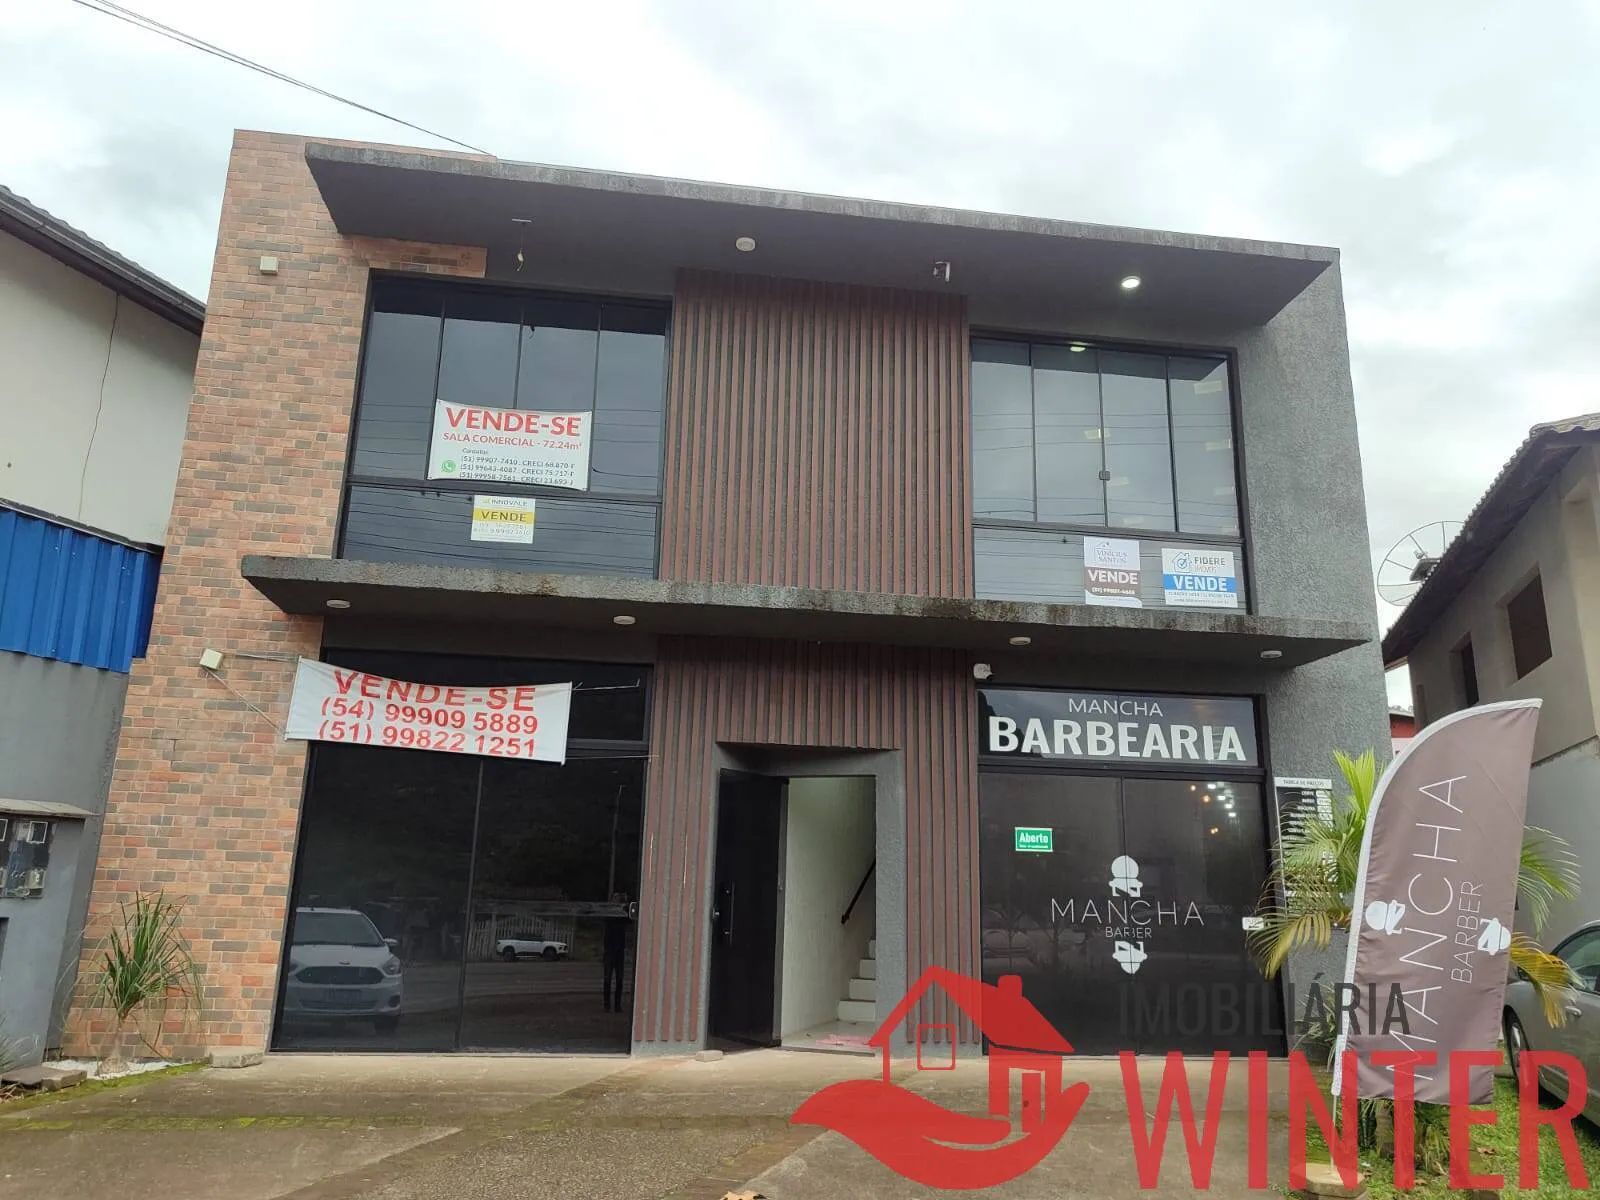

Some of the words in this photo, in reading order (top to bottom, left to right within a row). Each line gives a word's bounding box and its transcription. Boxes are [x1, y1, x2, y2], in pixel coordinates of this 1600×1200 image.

[446, 406, 582, 437] VENDE-SE
[443, 432, 471, 442] SALA
[472, 433, 535, 447] COMERCIAL
[521, 467, 543, 475] CRECI
[522, 459, 543, 467] CRECI
[481, 510, 528, 523] VENDE
[1194, 556, 1226, 566] FIDERE
[1087, 568, 1139, 585] VENDE
[1172, 575, 1228, 592] VENDE
[333, 669, 537, 713] VENDE-SE
[321, 696, 375, 721] (54)
[384, 703, 467, 730] 99909
[472, 712, 539, 735] 5889
[1068, 697, 1164, 718] MANCHA
[318, 719, 373, 745] (51)
[382, 725, 466, 752] 99822
[474, 734, 536, 758] 1251
[988, 715, 1248, 762] BARBEARIA
[1019, 831, 1049, 845] Aberto
[1051, 897, 1205, 927] MANCHA
[1450, 880, 1485, 985] BARBER
